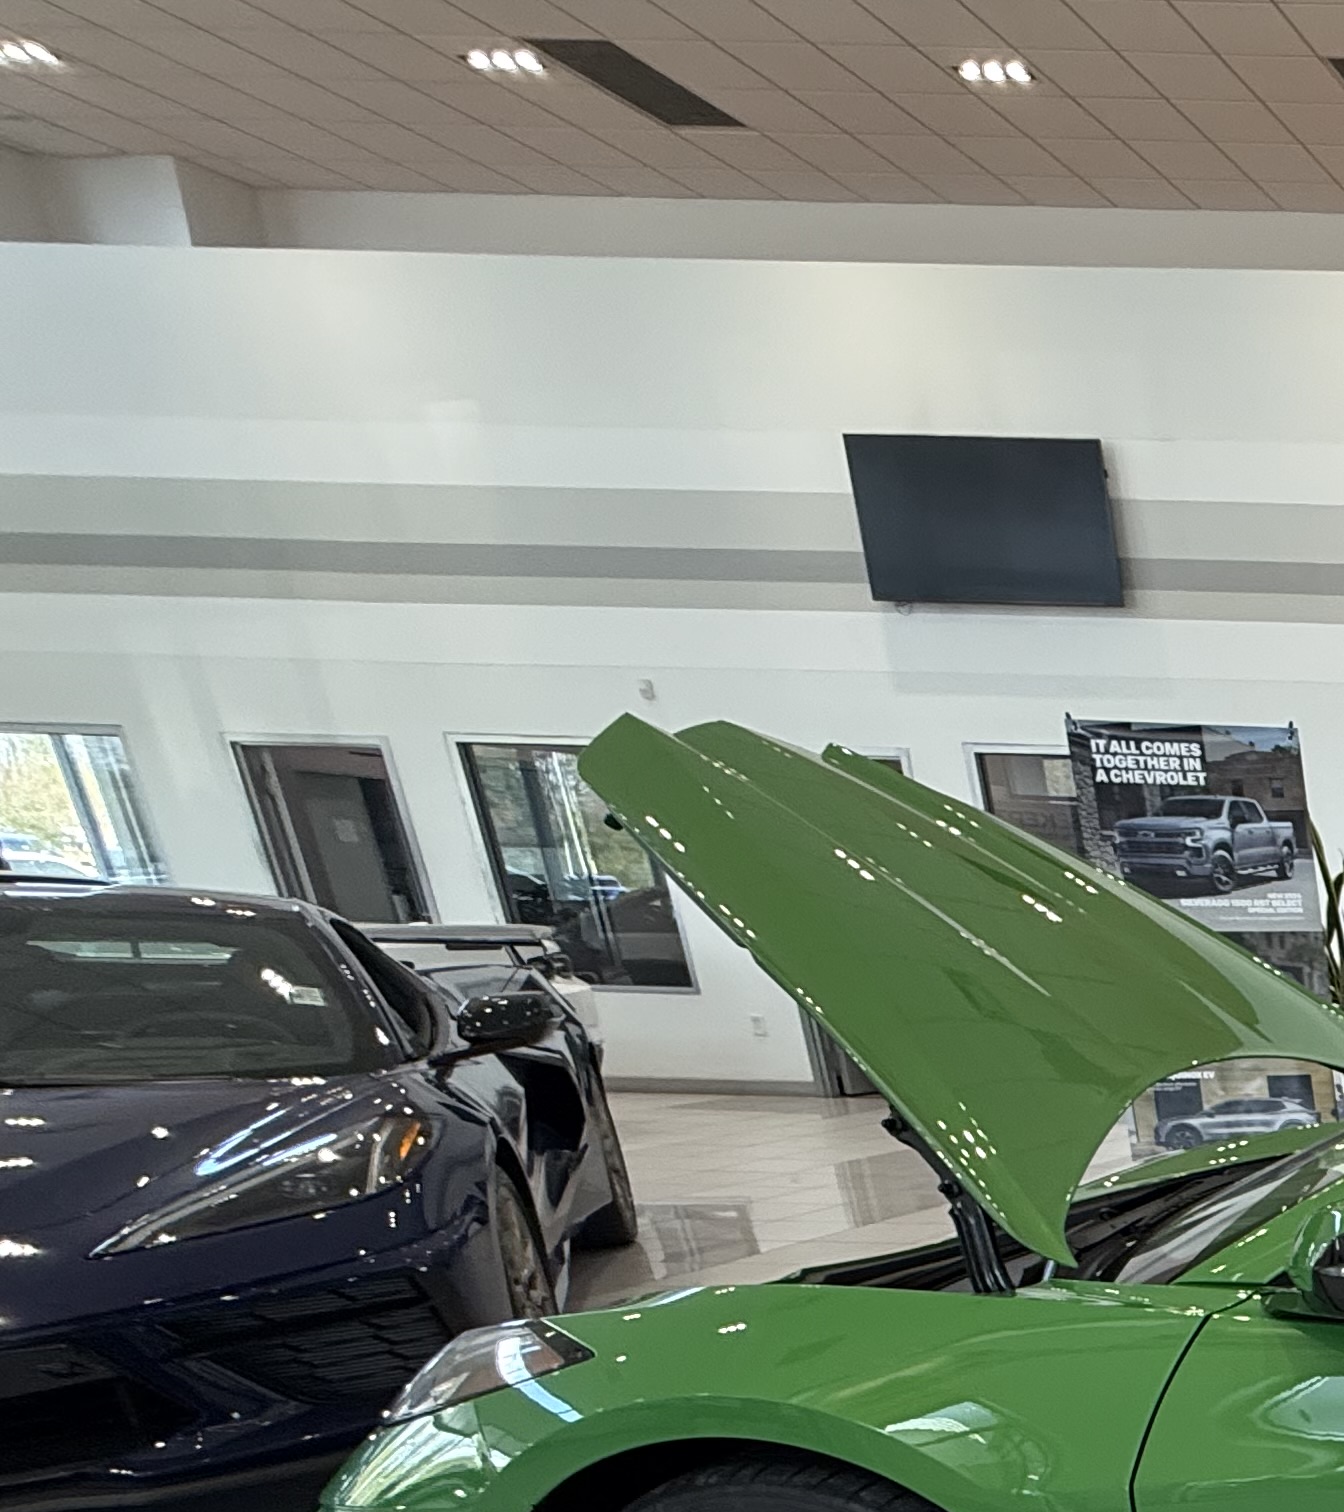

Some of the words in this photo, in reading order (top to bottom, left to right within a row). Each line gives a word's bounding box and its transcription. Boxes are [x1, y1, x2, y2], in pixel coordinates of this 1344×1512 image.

[1090, 739, 1107, 753] IT
[1109, 740, 1140, 754] ALL
[1141, 741, 1202, 757] COMES
[1092, 754, 1182, 770] TOGETHER
[1182, 757, 1202, 771] IN
[1096, 768, 1110, 783] A
[1110, 769, 1207, 786] CHEVROLET
